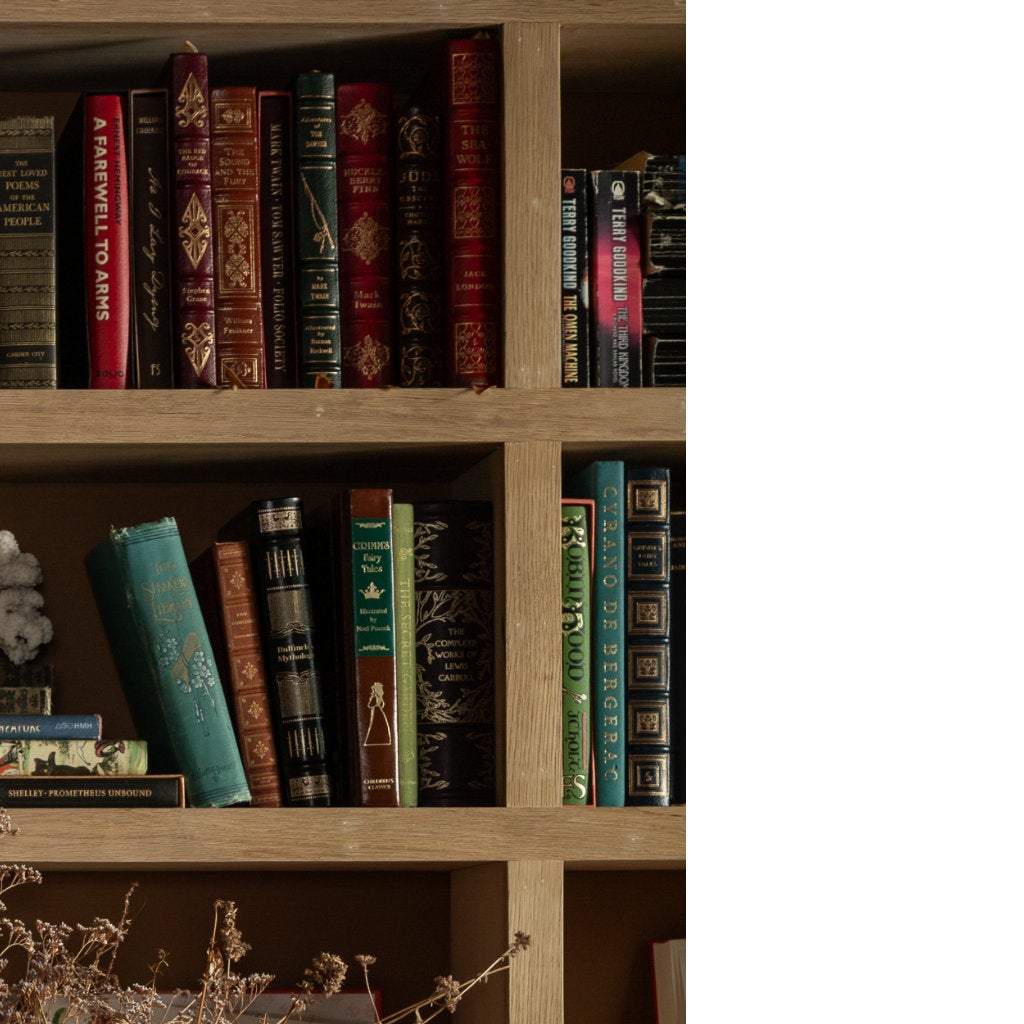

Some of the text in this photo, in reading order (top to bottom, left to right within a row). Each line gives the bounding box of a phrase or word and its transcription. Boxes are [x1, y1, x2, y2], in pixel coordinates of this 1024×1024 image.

[20, 169, 48, 177] LOVED
[112, 117, 123, 226] ERNEST HEMINGWAY
[5, 181, 40, 190] POEMS
[4, 217, 43, 226] PEOPLE
[93, 116, 111, 322] A FAREWELL TO ARMS
[270, 122, 287, 372] MARK TWAIN TOM SAWYER FOLIO SOCIETY
[611, 207, 629, 350] TERRY GOODKIND THE THIRD
[354, 290, 380, 299] Mark
[562, 198, 578, 384] TERRY GOODKIND THE OMEN MACHINE
[363, 553, 382, 563] Fairy
[362, 564, 383, 573] Tales
[448, 627, 464, 635] THE
[603, 485, 619, 782] CYRANO DE BERGERAC
[400, 578, 414, 735] THE SECRET GARDEN
[8, 789, 44, 798] SHELLEY
[48, 789, 106, 798] PROMETHEUS
[108, 789, 152, 798] UNBOUND
